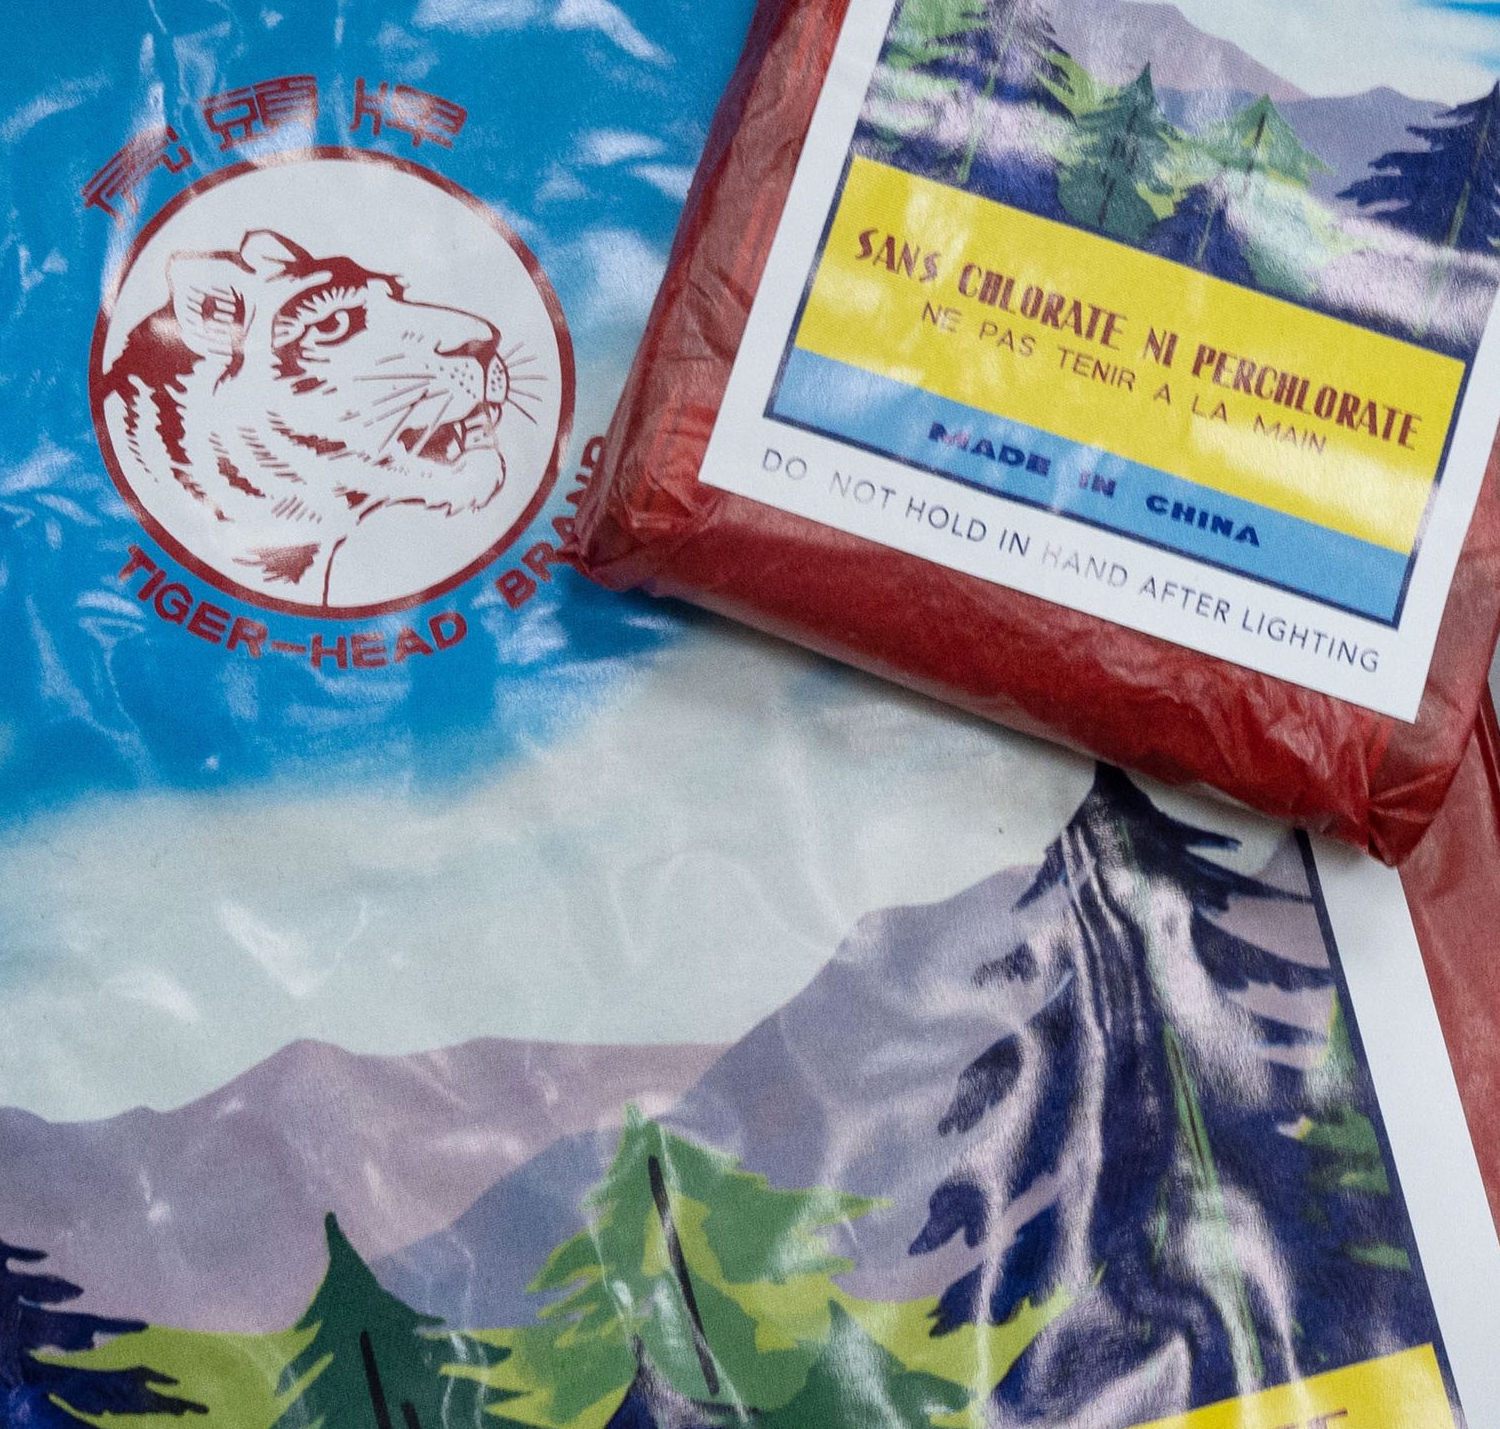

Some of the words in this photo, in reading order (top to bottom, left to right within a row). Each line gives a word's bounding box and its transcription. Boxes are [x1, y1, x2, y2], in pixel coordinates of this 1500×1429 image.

[855, 227, 940, 285] SANS
[957, 261, 1129, 350] CHLORATE
[1142, 326, 1178, 368] NI
[1191, 344, 1422, 450] PERCHLORATE
[921, 301, 962, 334] NE
[979, 318, 1037, 358] PAS
[1056, 346, 1136, 393] TENIR
[1153, 384, 1174, 406] A
[1191, 393, 1230, 424] LA
[1253, 411, 1327, 456] MAIN
[762, 447, 809, 483] DO
[828, 471, 897, 511] NOT
[905, 496, 988, 546] HOLD
[1000, 527, 1030, 558] IN
[1040, 541, 1129, 591] HAND
[1139, 572, 1231, 624] AFTER
[1241, 606, 1380, 673] LIGHTING
[928, 422, 1053, 478] MADE
[1078, 470, 1117, 500] IN
[1145, 494, 1262, 550] CHINA
[116, 545, 468, 671] TIGER-HEAD
